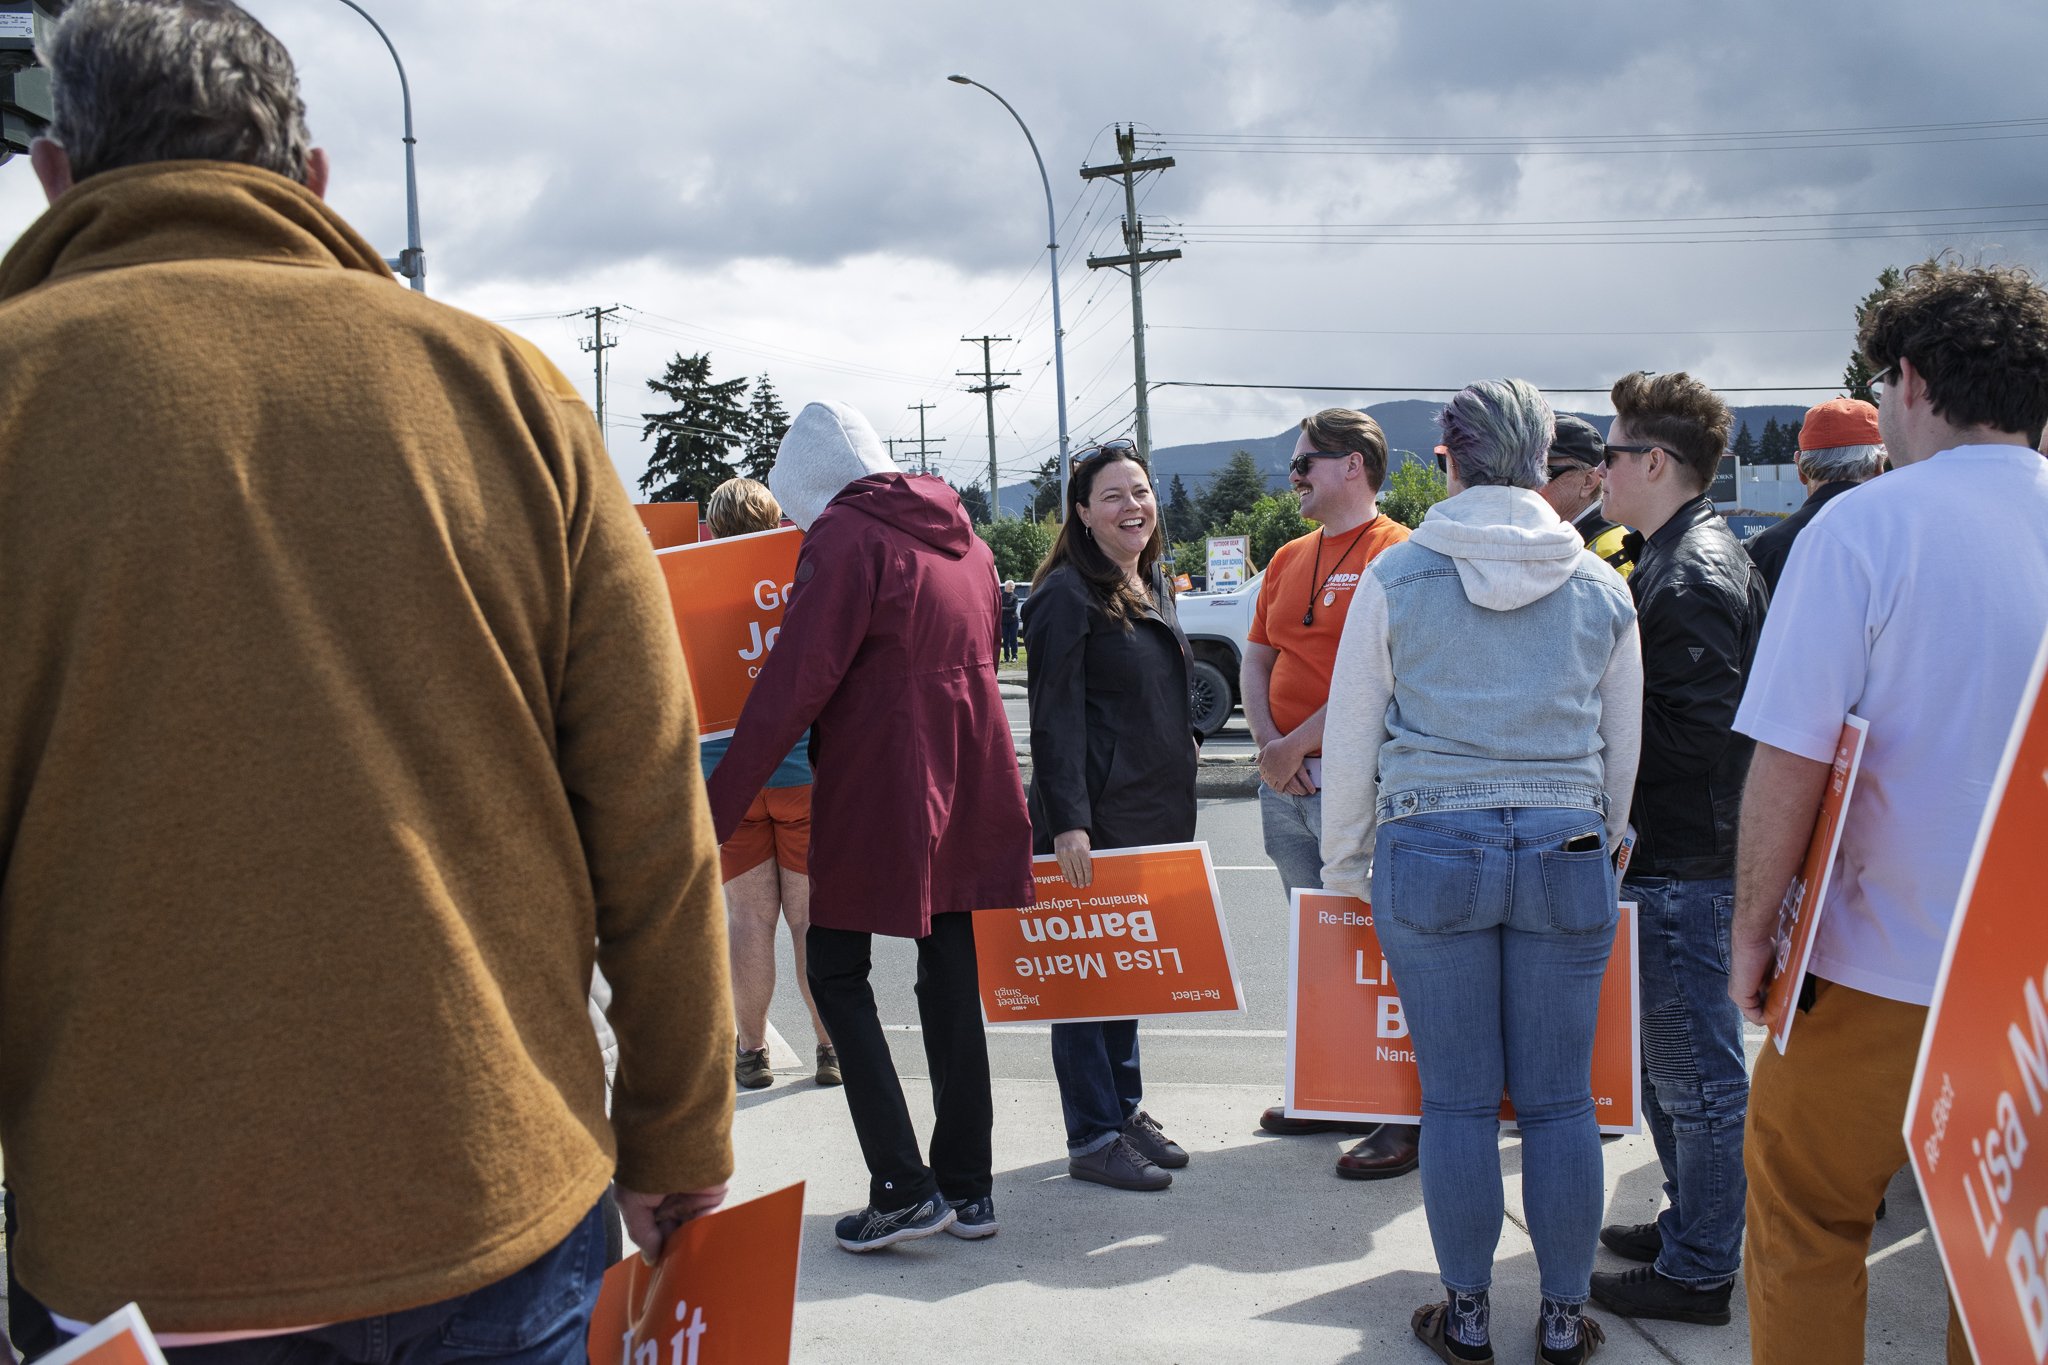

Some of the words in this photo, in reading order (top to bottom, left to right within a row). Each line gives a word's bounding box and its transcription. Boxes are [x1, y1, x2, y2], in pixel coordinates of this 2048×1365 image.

[1332, 573, 1359, 582] NDP
[1019, 910, 1159, 943] Barron
[1015, 952, 1108, 983] Marie
[1115, 948, 1184, 976] Lisa
[1356, 950, 1396, 986] Li
[994, 987, 1022, 998] Singh
[996, 994, 1041, 1007] Jagmeet
[1172, 989, 1221, 1001] Re-Elect
[1963, 1090, 2029, 1259] Lisa
[2007, 962, 2048, 1117] M
[670, 1300, 707, 1365] it
